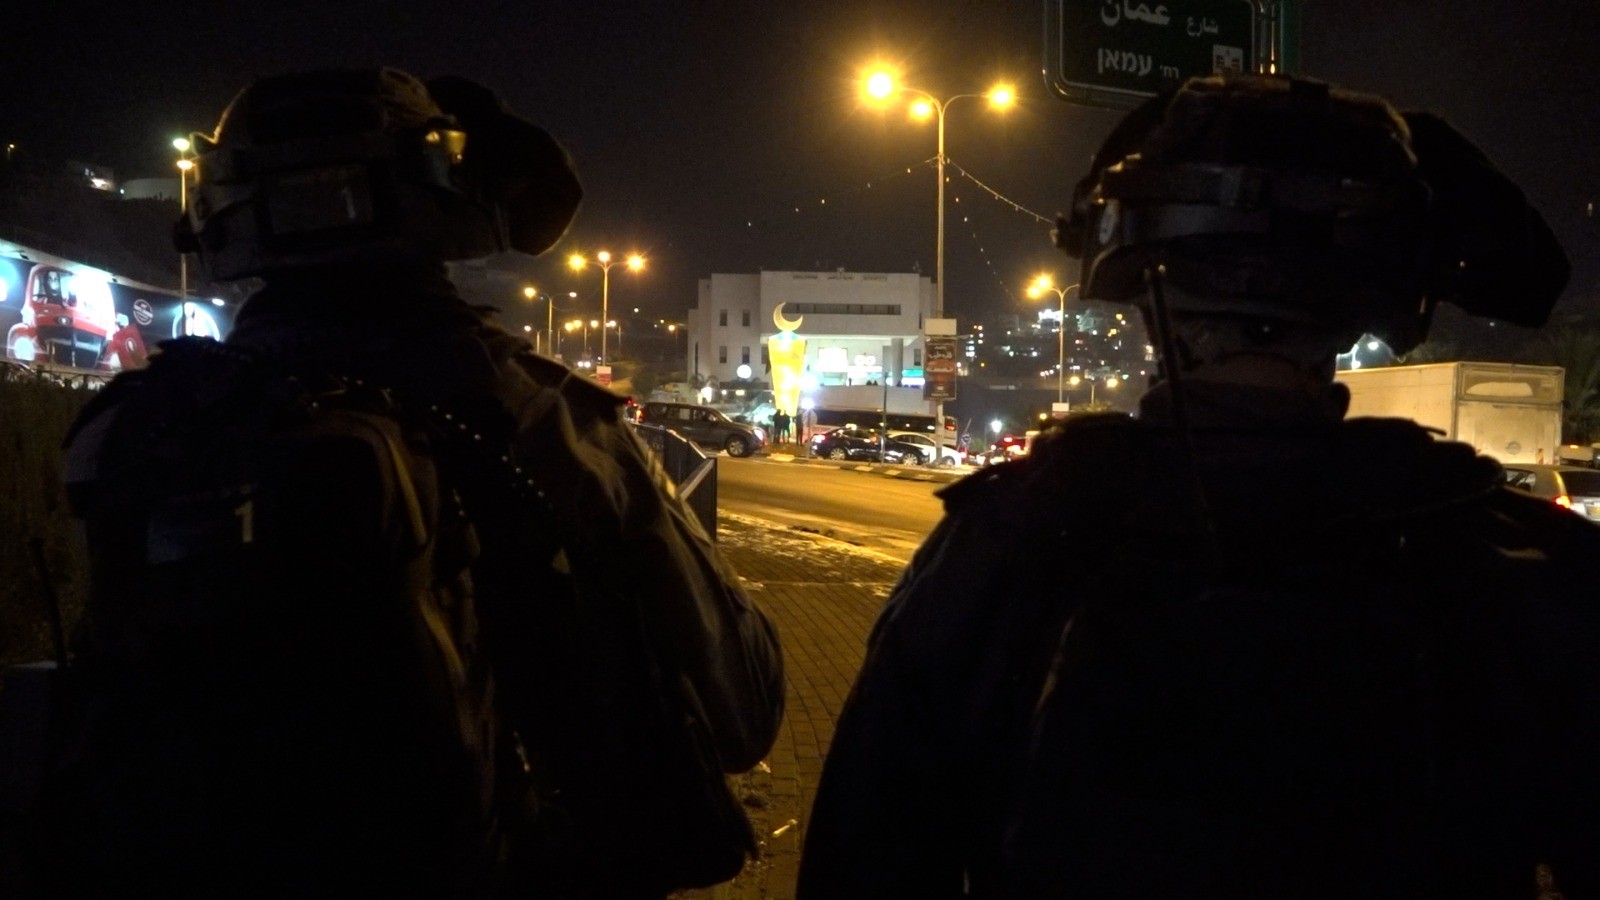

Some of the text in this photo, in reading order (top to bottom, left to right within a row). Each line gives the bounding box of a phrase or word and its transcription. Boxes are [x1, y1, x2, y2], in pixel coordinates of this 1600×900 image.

[1101, 0, 1219, 37] شارع عمان
[1097, 47, 1152, 77] עמאן
[233, 499, 256, 544] 1
